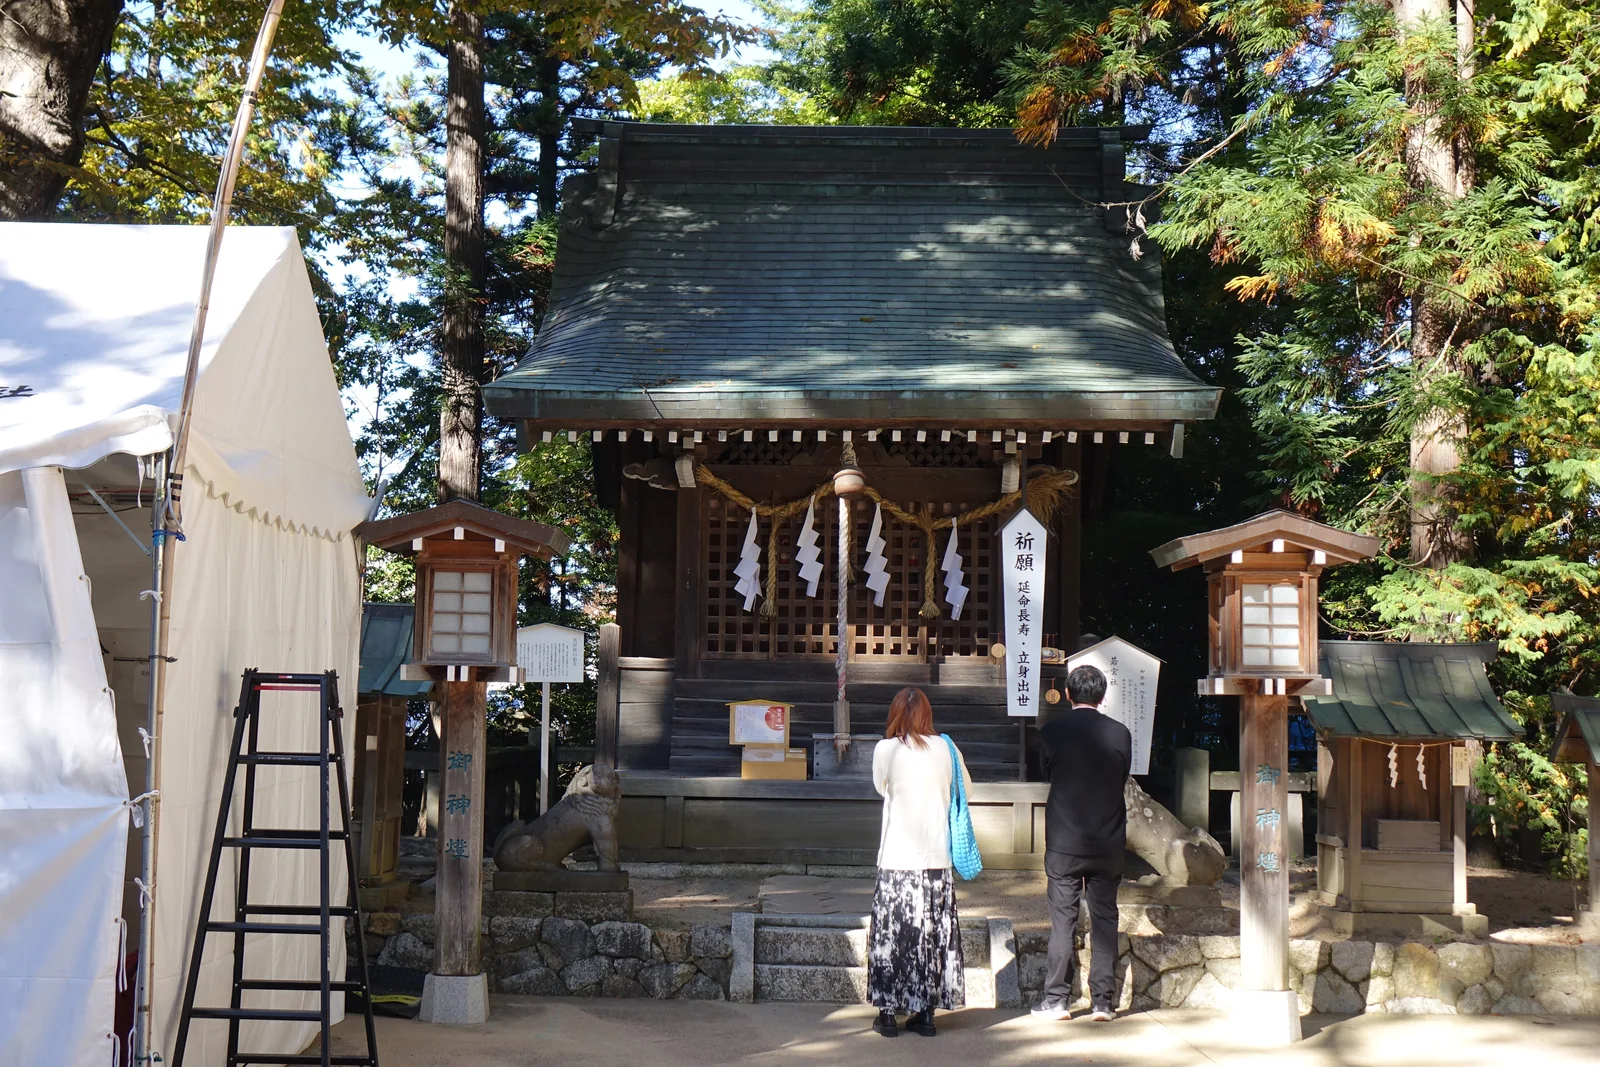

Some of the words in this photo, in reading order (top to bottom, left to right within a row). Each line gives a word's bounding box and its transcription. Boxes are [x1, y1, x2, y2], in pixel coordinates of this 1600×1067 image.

[1014, 532, 1035, 572] 祈願
[1016, 581, 1031, 707] 延命長寿・立身出世
[1109, 656, 1119, 686] 若宮社
[445, 751, 473, 859] 御神燈
[1256, 764, 1281, 872] 御神燈
